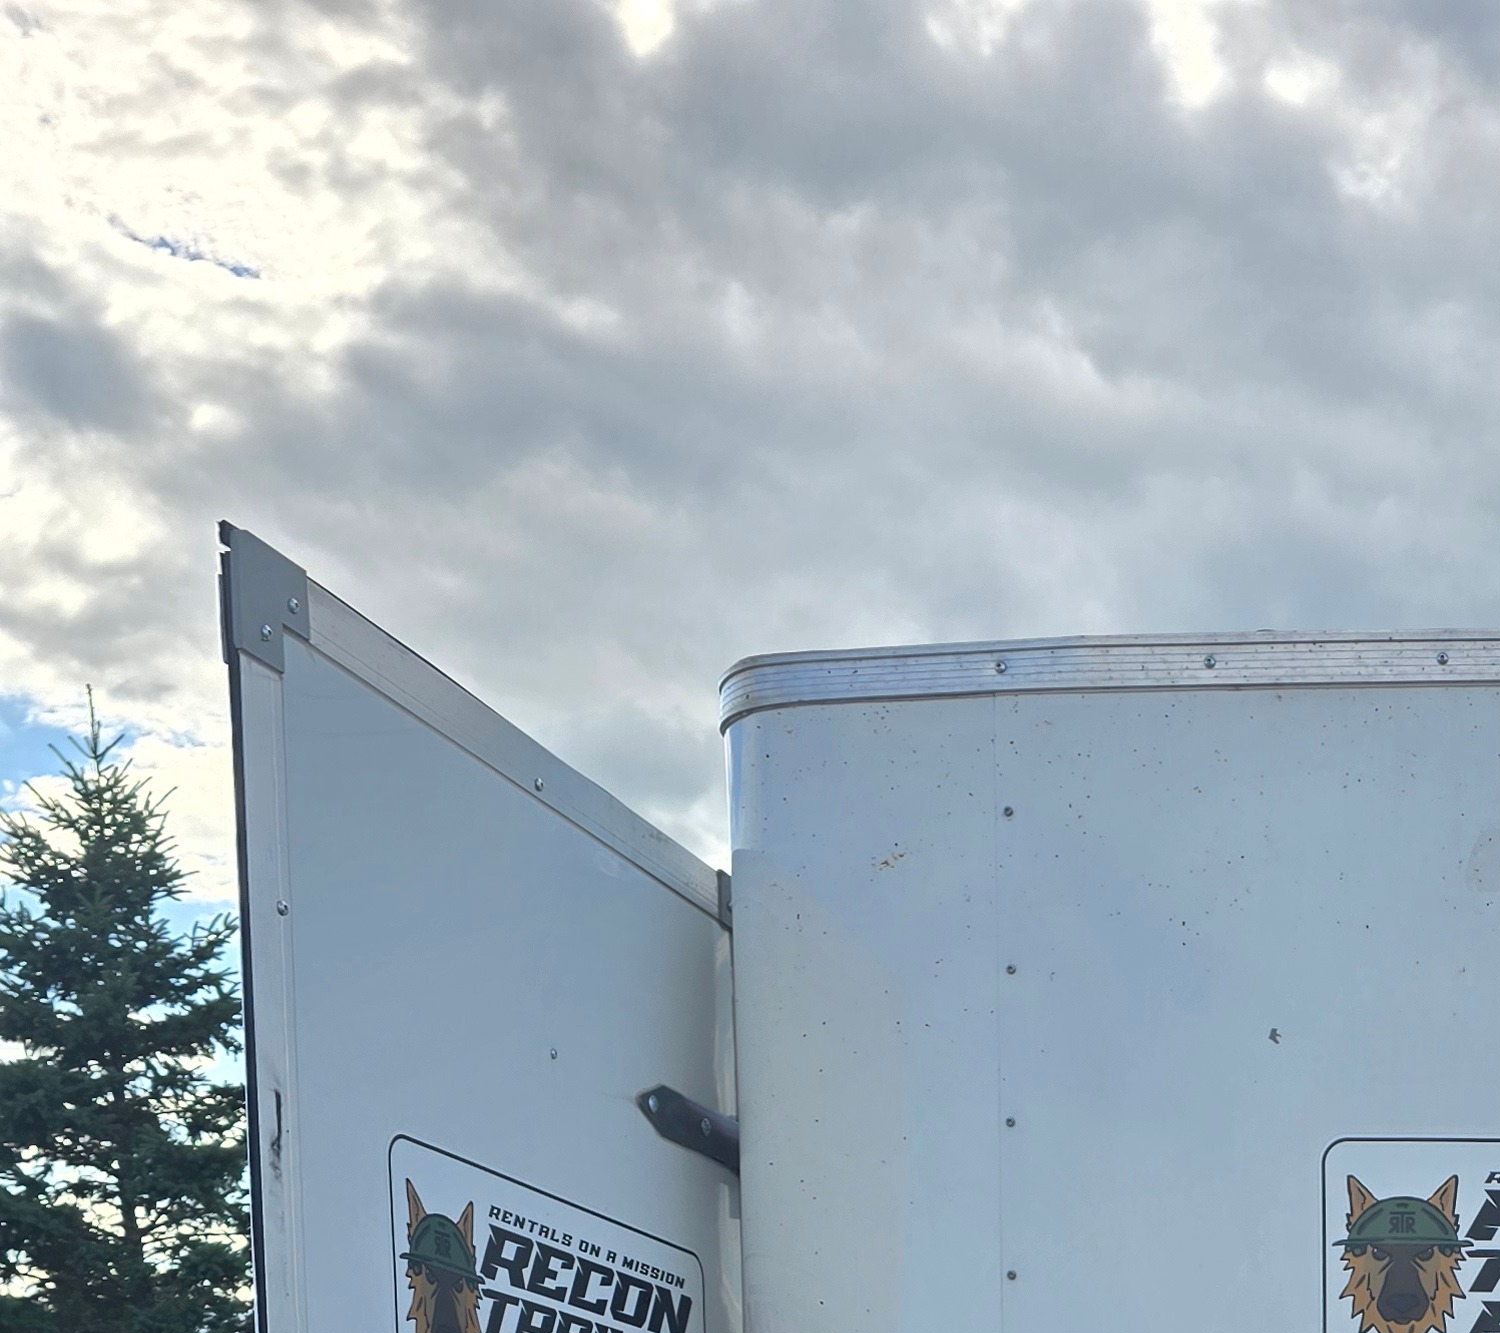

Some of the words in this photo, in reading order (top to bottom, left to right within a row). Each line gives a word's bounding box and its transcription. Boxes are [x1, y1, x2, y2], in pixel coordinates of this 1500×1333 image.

[488, 1205, 573, 1247] RENTALS
[578, 1239, 602, 1258] ON
[605, 1250, 618, 1264] A
[621, 1256, 686, 1290] MISSION
